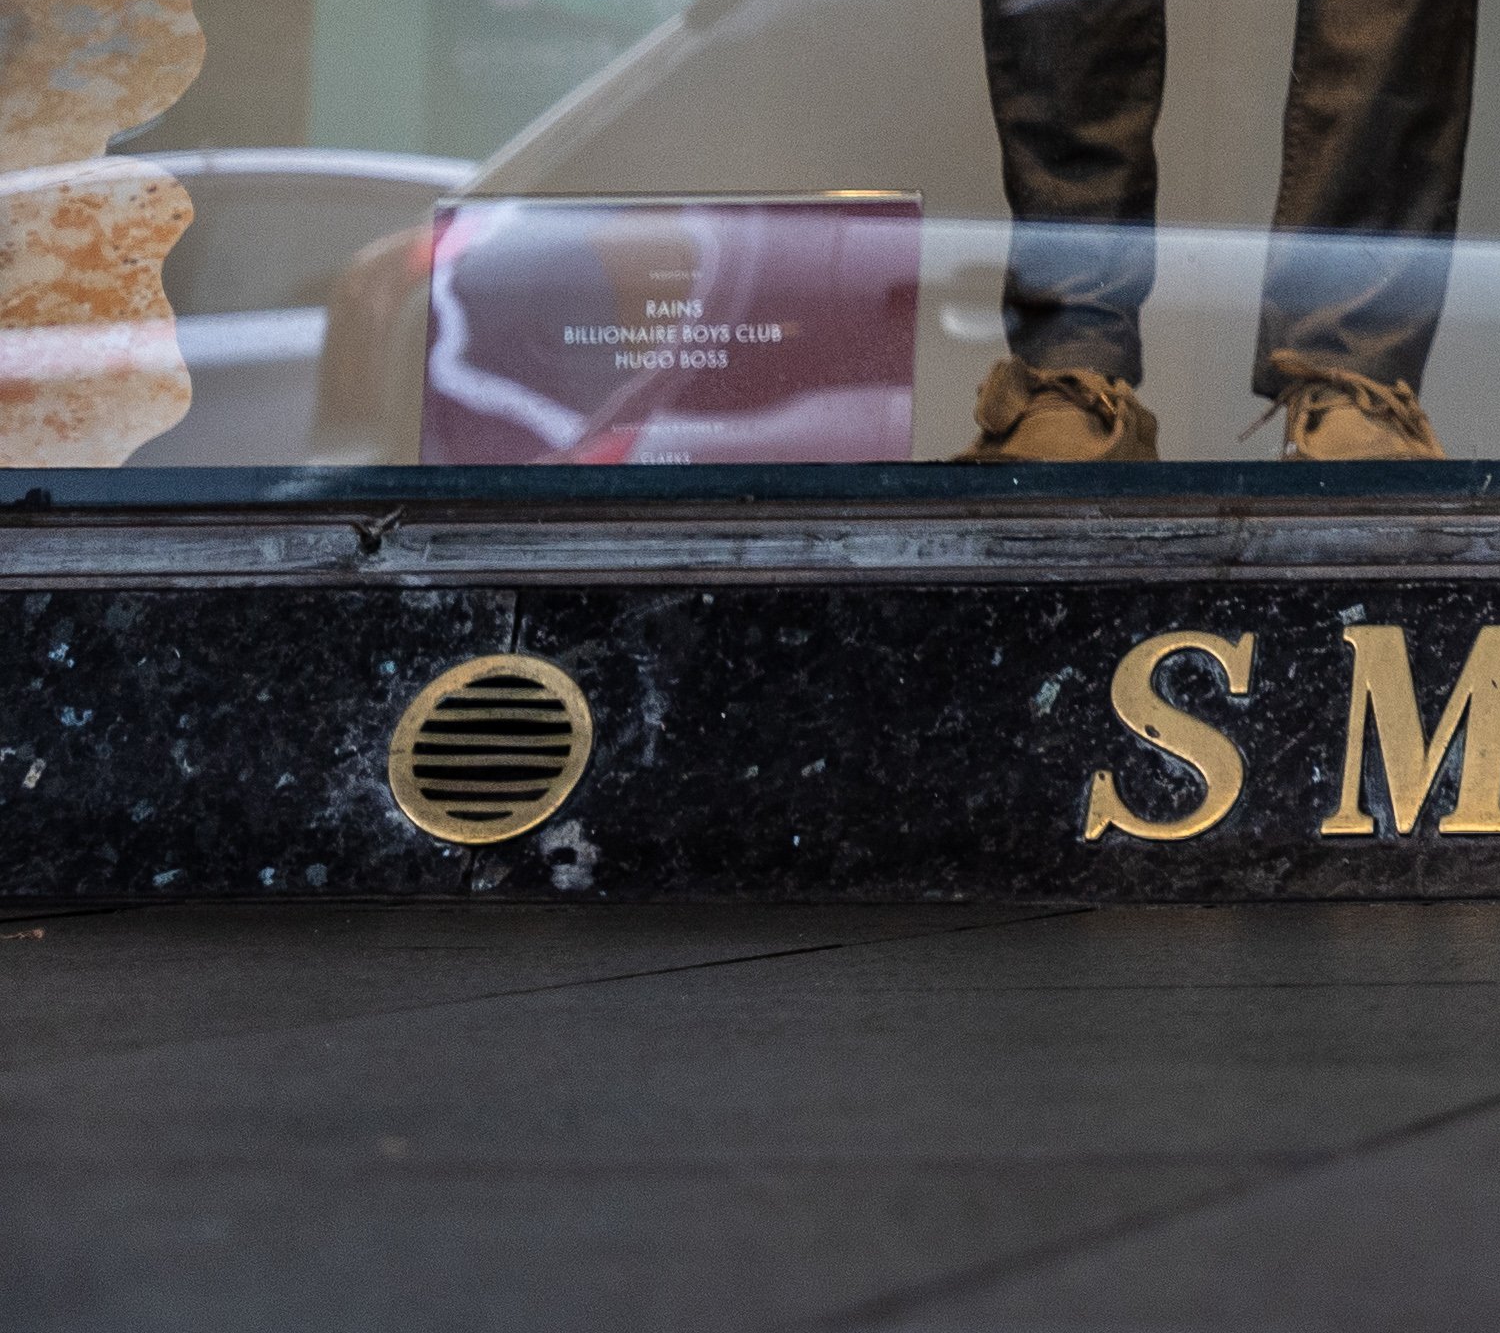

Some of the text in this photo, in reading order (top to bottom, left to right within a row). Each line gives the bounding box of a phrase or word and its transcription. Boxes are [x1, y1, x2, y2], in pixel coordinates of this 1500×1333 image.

[645, 300, 704, 318] RAINS
[564, 324, 783, 344] BILLIONAIRE BOYS CLUB
[615, 350, 729, 369] HUGO BOSS
